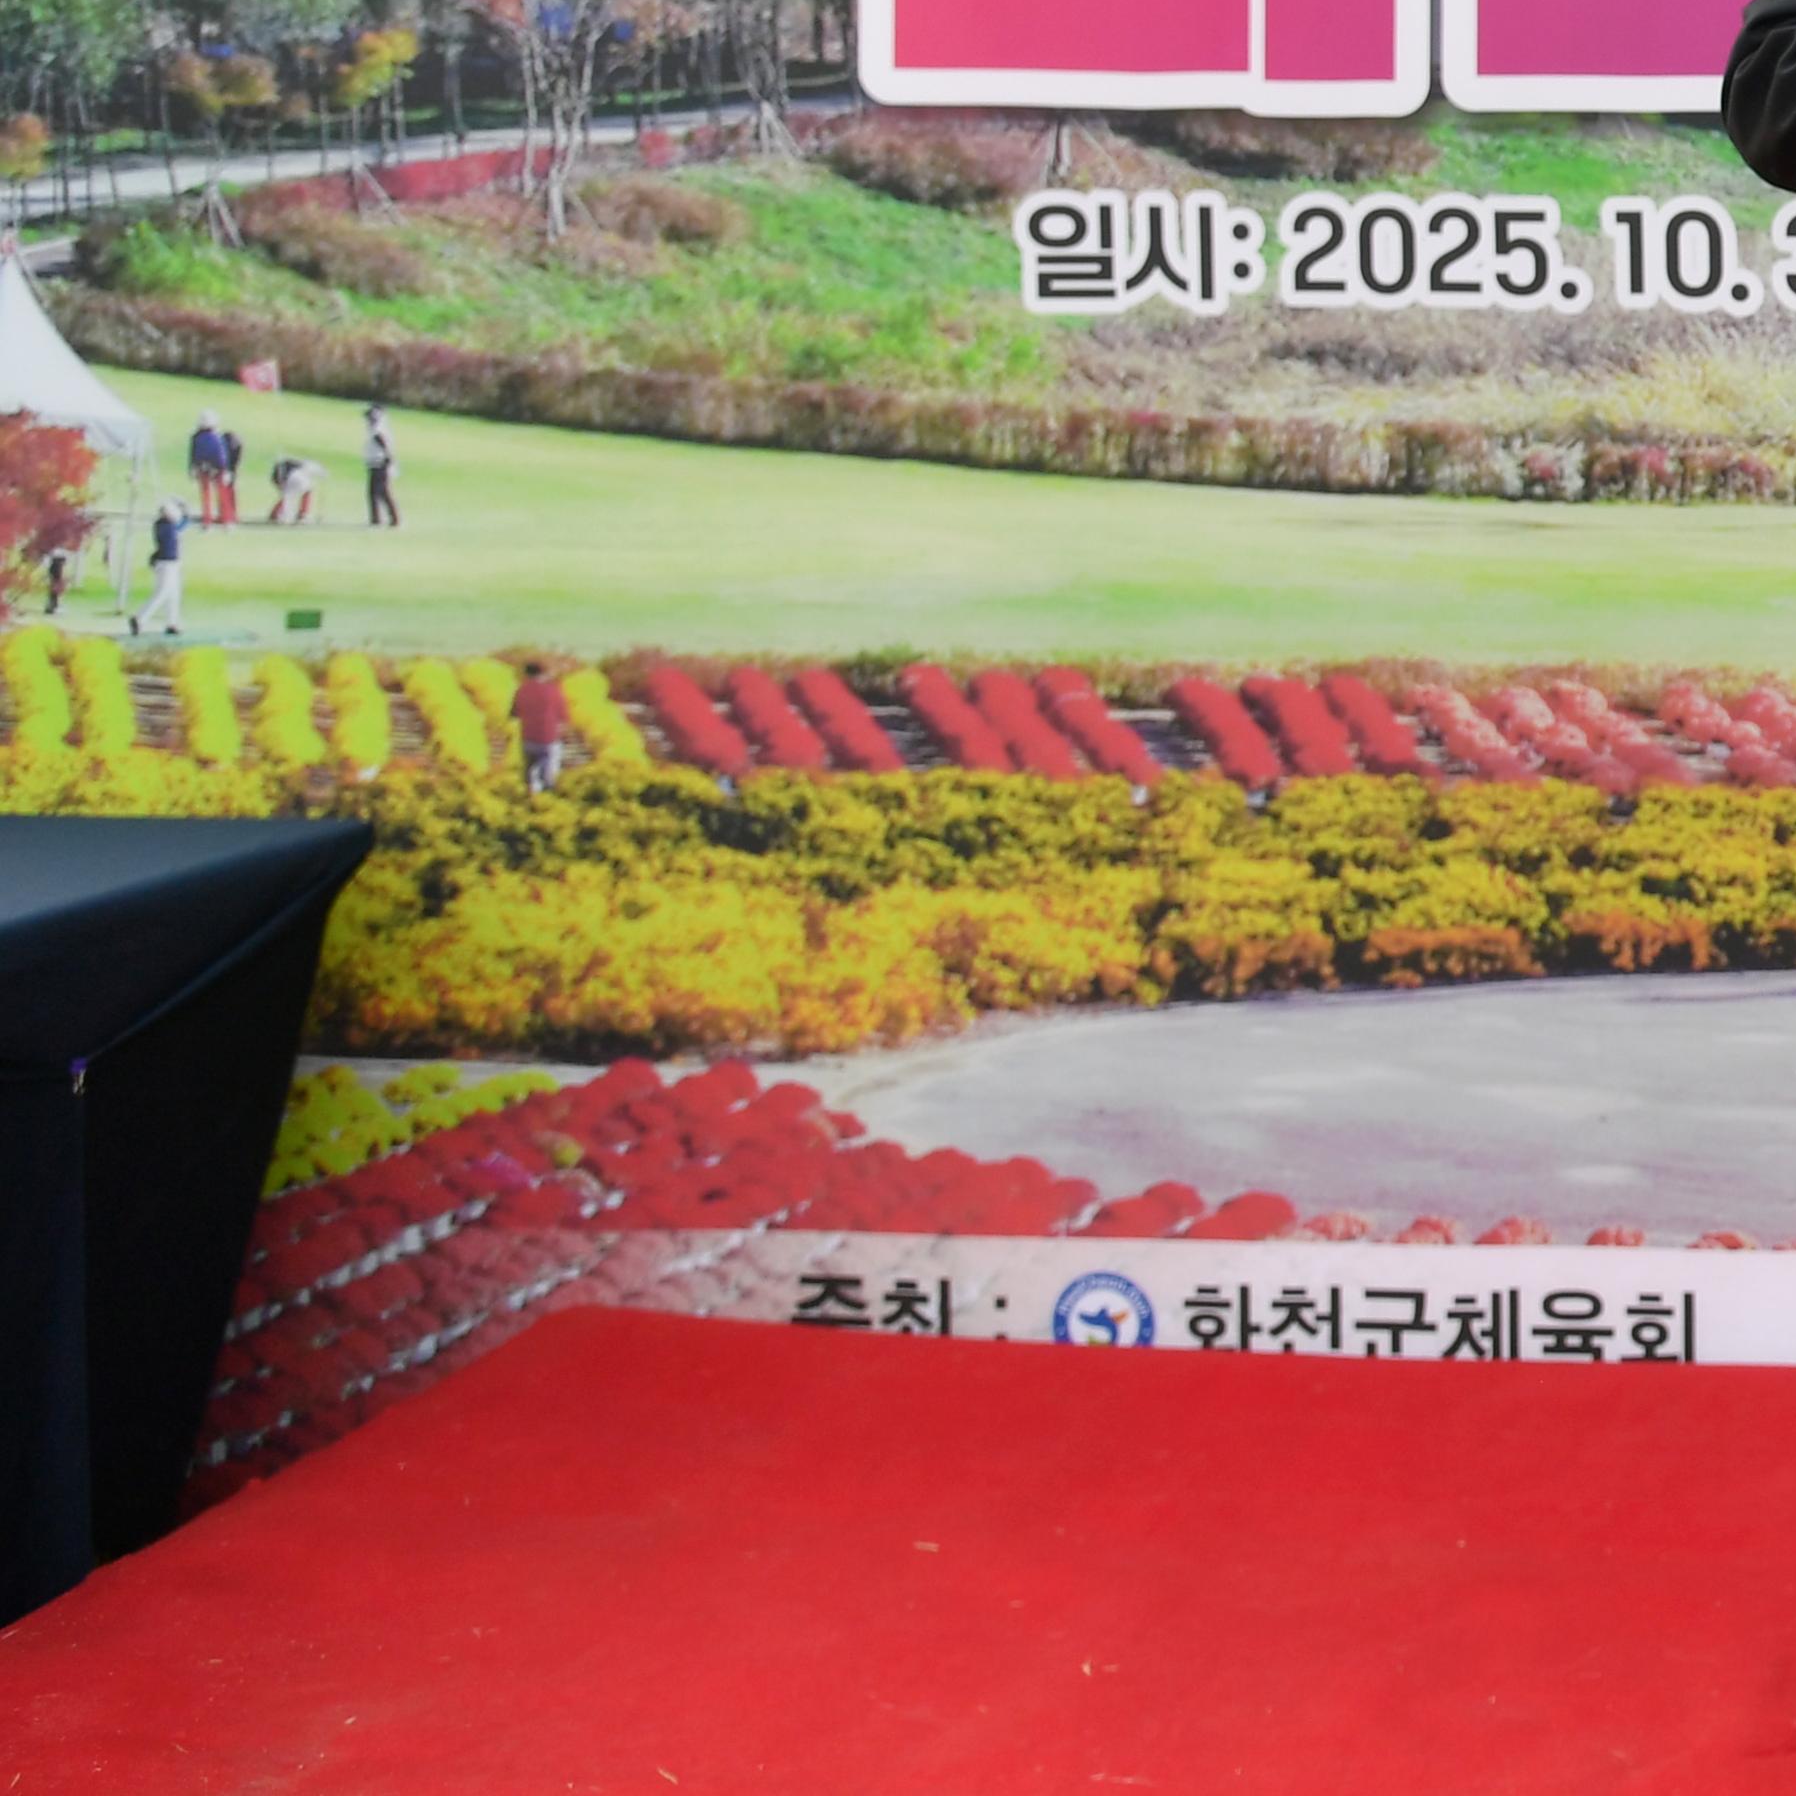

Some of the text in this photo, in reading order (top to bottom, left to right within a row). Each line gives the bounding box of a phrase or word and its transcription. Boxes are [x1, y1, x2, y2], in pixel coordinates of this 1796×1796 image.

[1028, 205, 1250, 300] 일시:
[1293, 207, 1578, 300] 2025.
[1615, 210, 1748, 302] 10.
[1184, 1285, 1695, 1365] 화천군체육회
